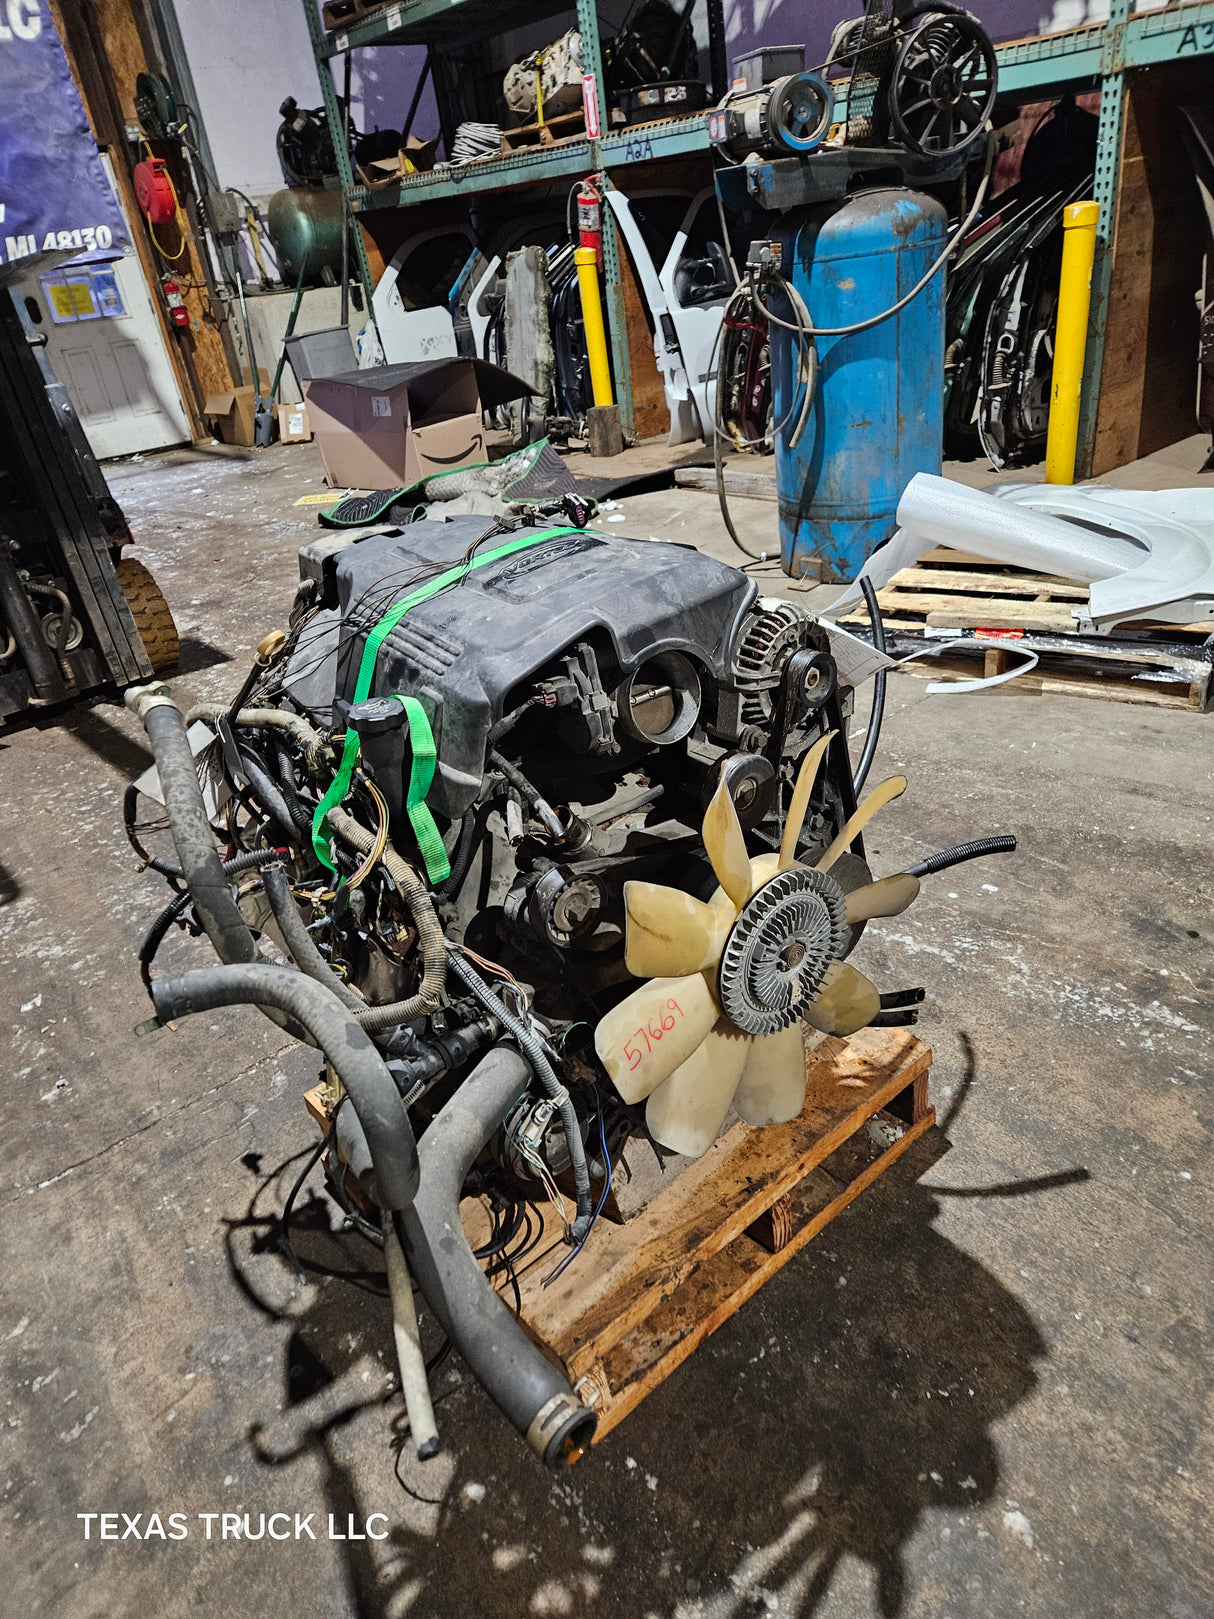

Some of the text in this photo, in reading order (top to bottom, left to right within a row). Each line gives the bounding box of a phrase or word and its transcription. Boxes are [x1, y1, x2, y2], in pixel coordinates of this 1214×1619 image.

[625, 137, 653, 162] A2A
[5, 224, 113, 261] MI 48130
[623, 997, 684, 1071] 57669
